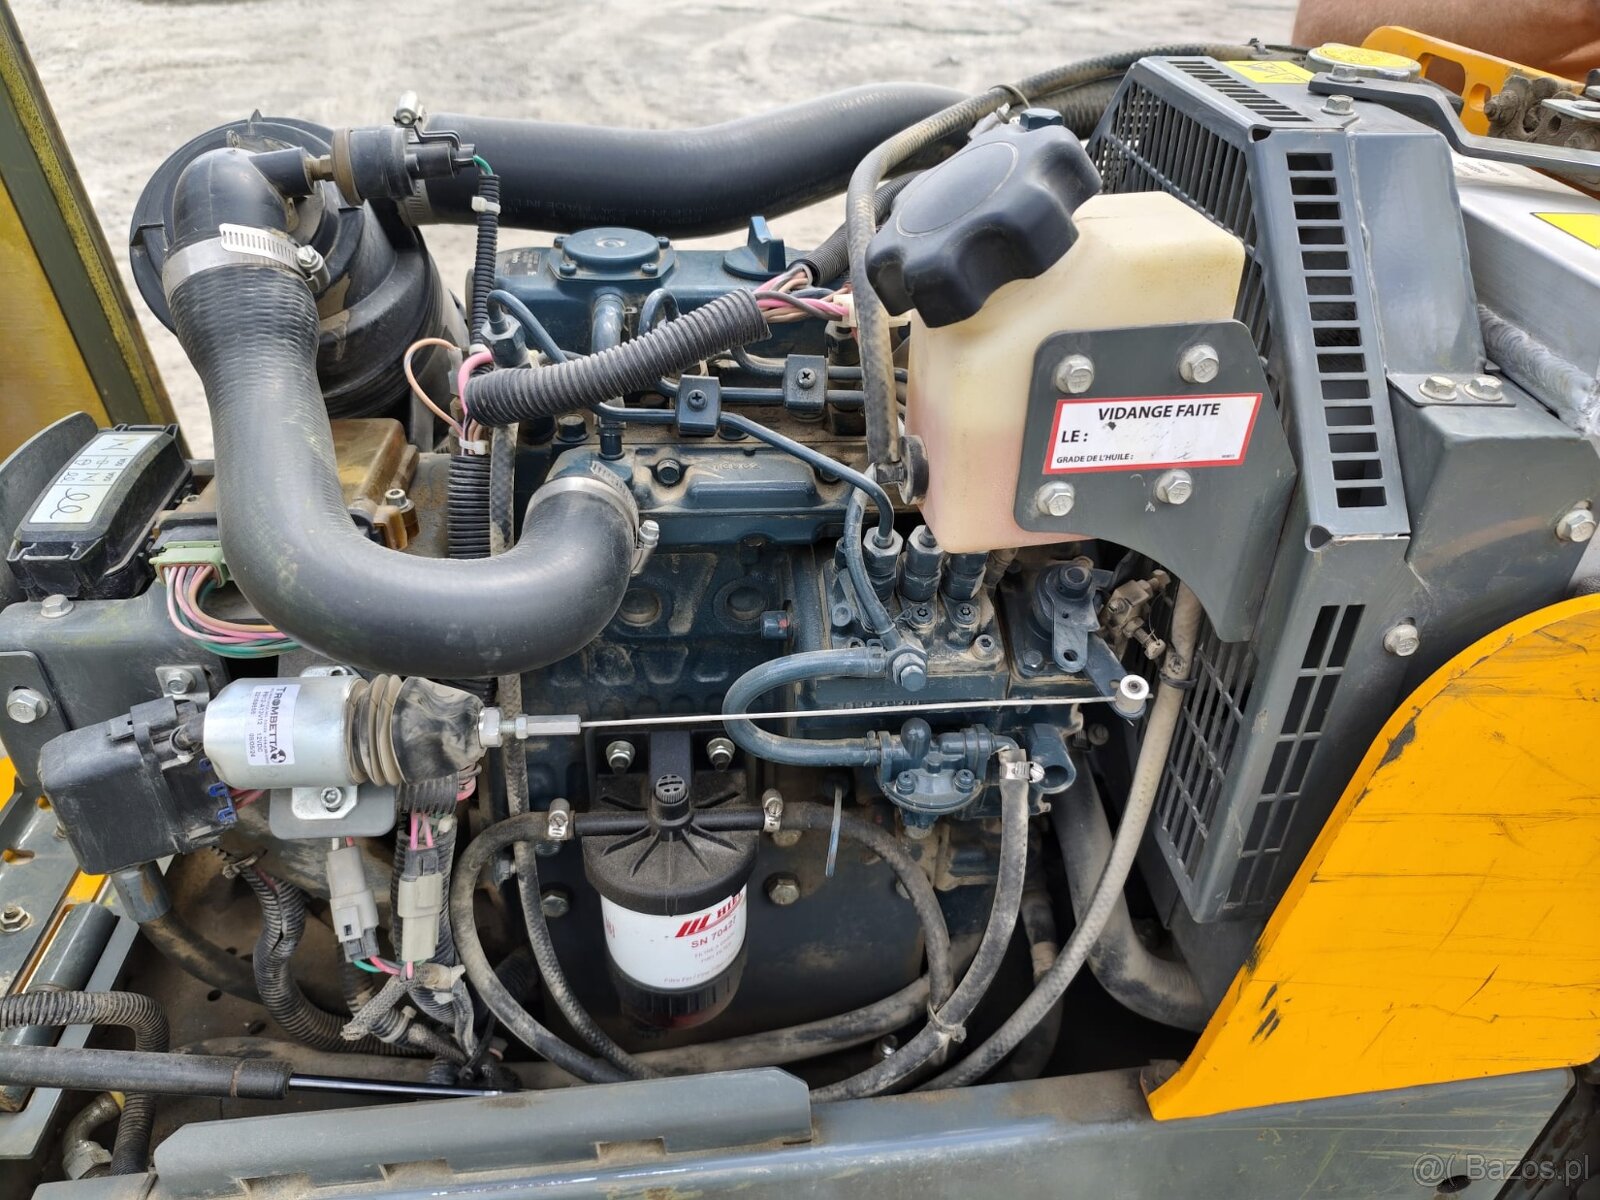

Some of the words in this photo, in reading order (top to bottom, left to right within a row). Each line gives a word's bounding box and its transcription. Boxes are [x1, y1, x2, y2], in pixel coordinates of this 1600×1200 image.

[1098, 405, 1172, 421] VIDANGE
[1176, 403, 1221, 417] FAITE
[1056, 455, 1085, 464] GRADE
[1086, 454, 1098, 463] DE
[269, 686, 287, 753] TROMBETTA
[691, 937, 708, 948] SN
